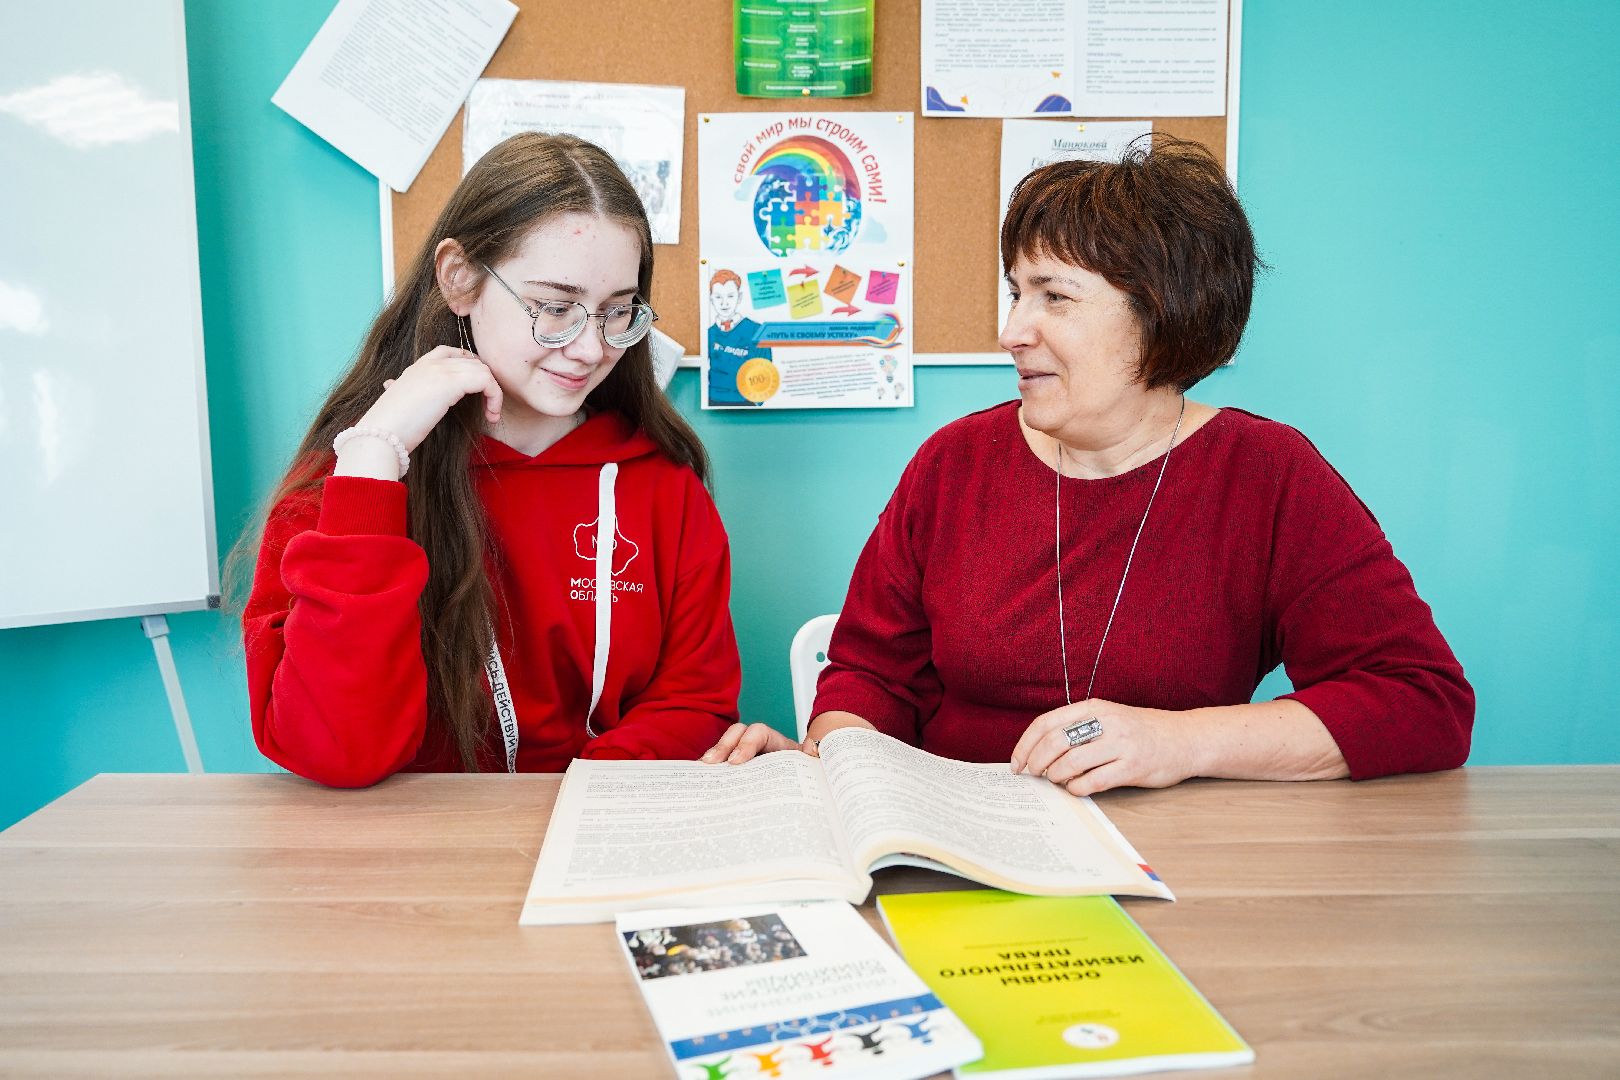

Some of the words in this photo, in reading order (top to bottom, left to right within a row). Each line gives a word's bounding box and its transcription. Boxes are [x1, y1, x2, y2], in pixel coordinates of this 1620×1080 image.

[571, 578, 644, 593] МОСВСКАЯ
[570, 590, 618, 602] ОБЛЬ
[493, 682, 518, 747] ДЕЙСТВУЙ
[997, 948, 1071, 960] ПРАВА
[939, 955, 1145, 978] ИЗБИРАТЕЛЬНОГО
[1000, 970, 1101, 986] ОСНОВЫ
